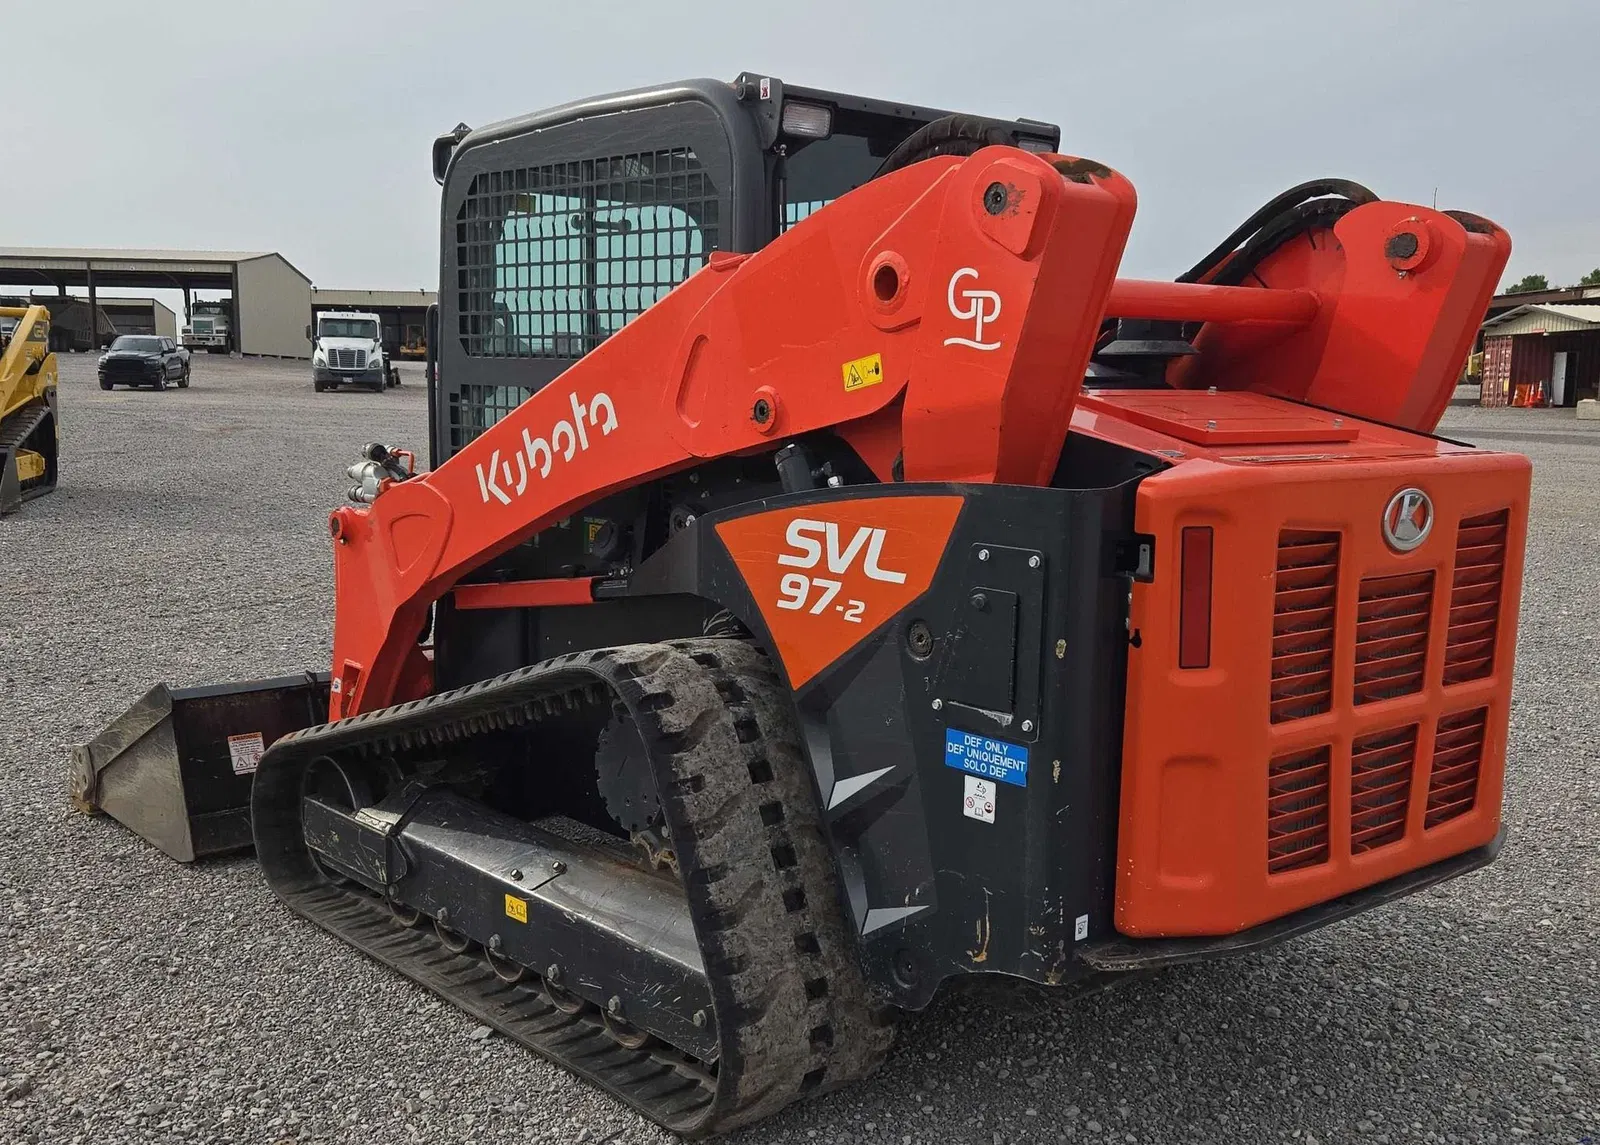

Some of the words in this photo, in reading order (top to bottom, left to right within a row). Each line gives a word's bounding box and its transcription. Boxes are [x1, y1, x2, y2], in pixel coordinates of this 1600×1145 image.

[475, 392, 618, 505] Kubota
[777, 518, 907, 584] SVL
[776, 573, 866, 623] 97-2
[947, 742, 965, 755] DEF
[966, 747, 1026, 771] UNIQUEMENT
[964, 735, 982, 747] DEF
[985, 740, 1009, 755] ONLY
[963, 758, 987, 773] SOLO
[989, 765, 1007, 778] DEF
